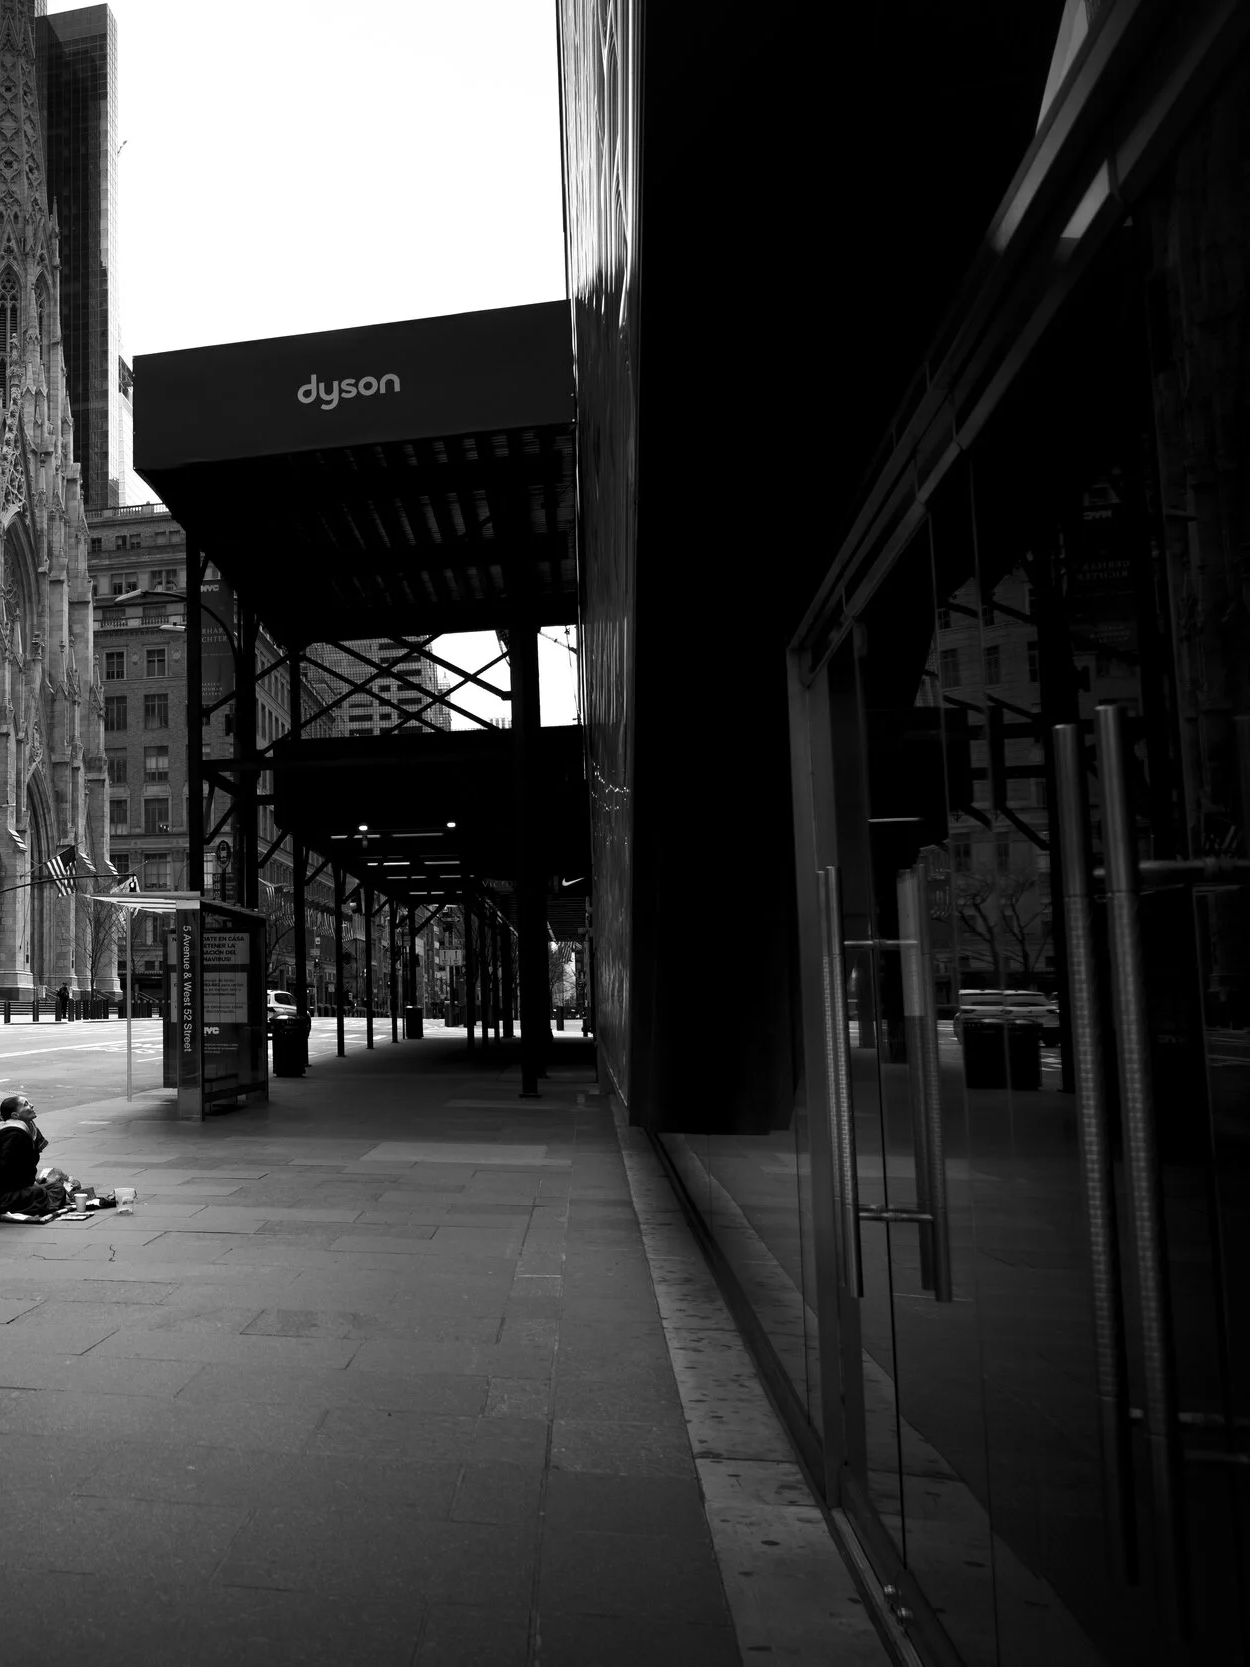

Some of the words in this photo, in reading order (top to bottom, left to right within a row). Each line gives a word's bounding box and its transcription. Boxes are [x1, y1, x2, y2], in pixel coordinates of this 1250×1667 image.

[297, 373, 401, 411] dyson
[183, 934, 192, 970] Avenue
[183, 981, 192, 1006] West
[183, 1008, 192, 1021] 52
[183, 1023, 193, 1052] Street
